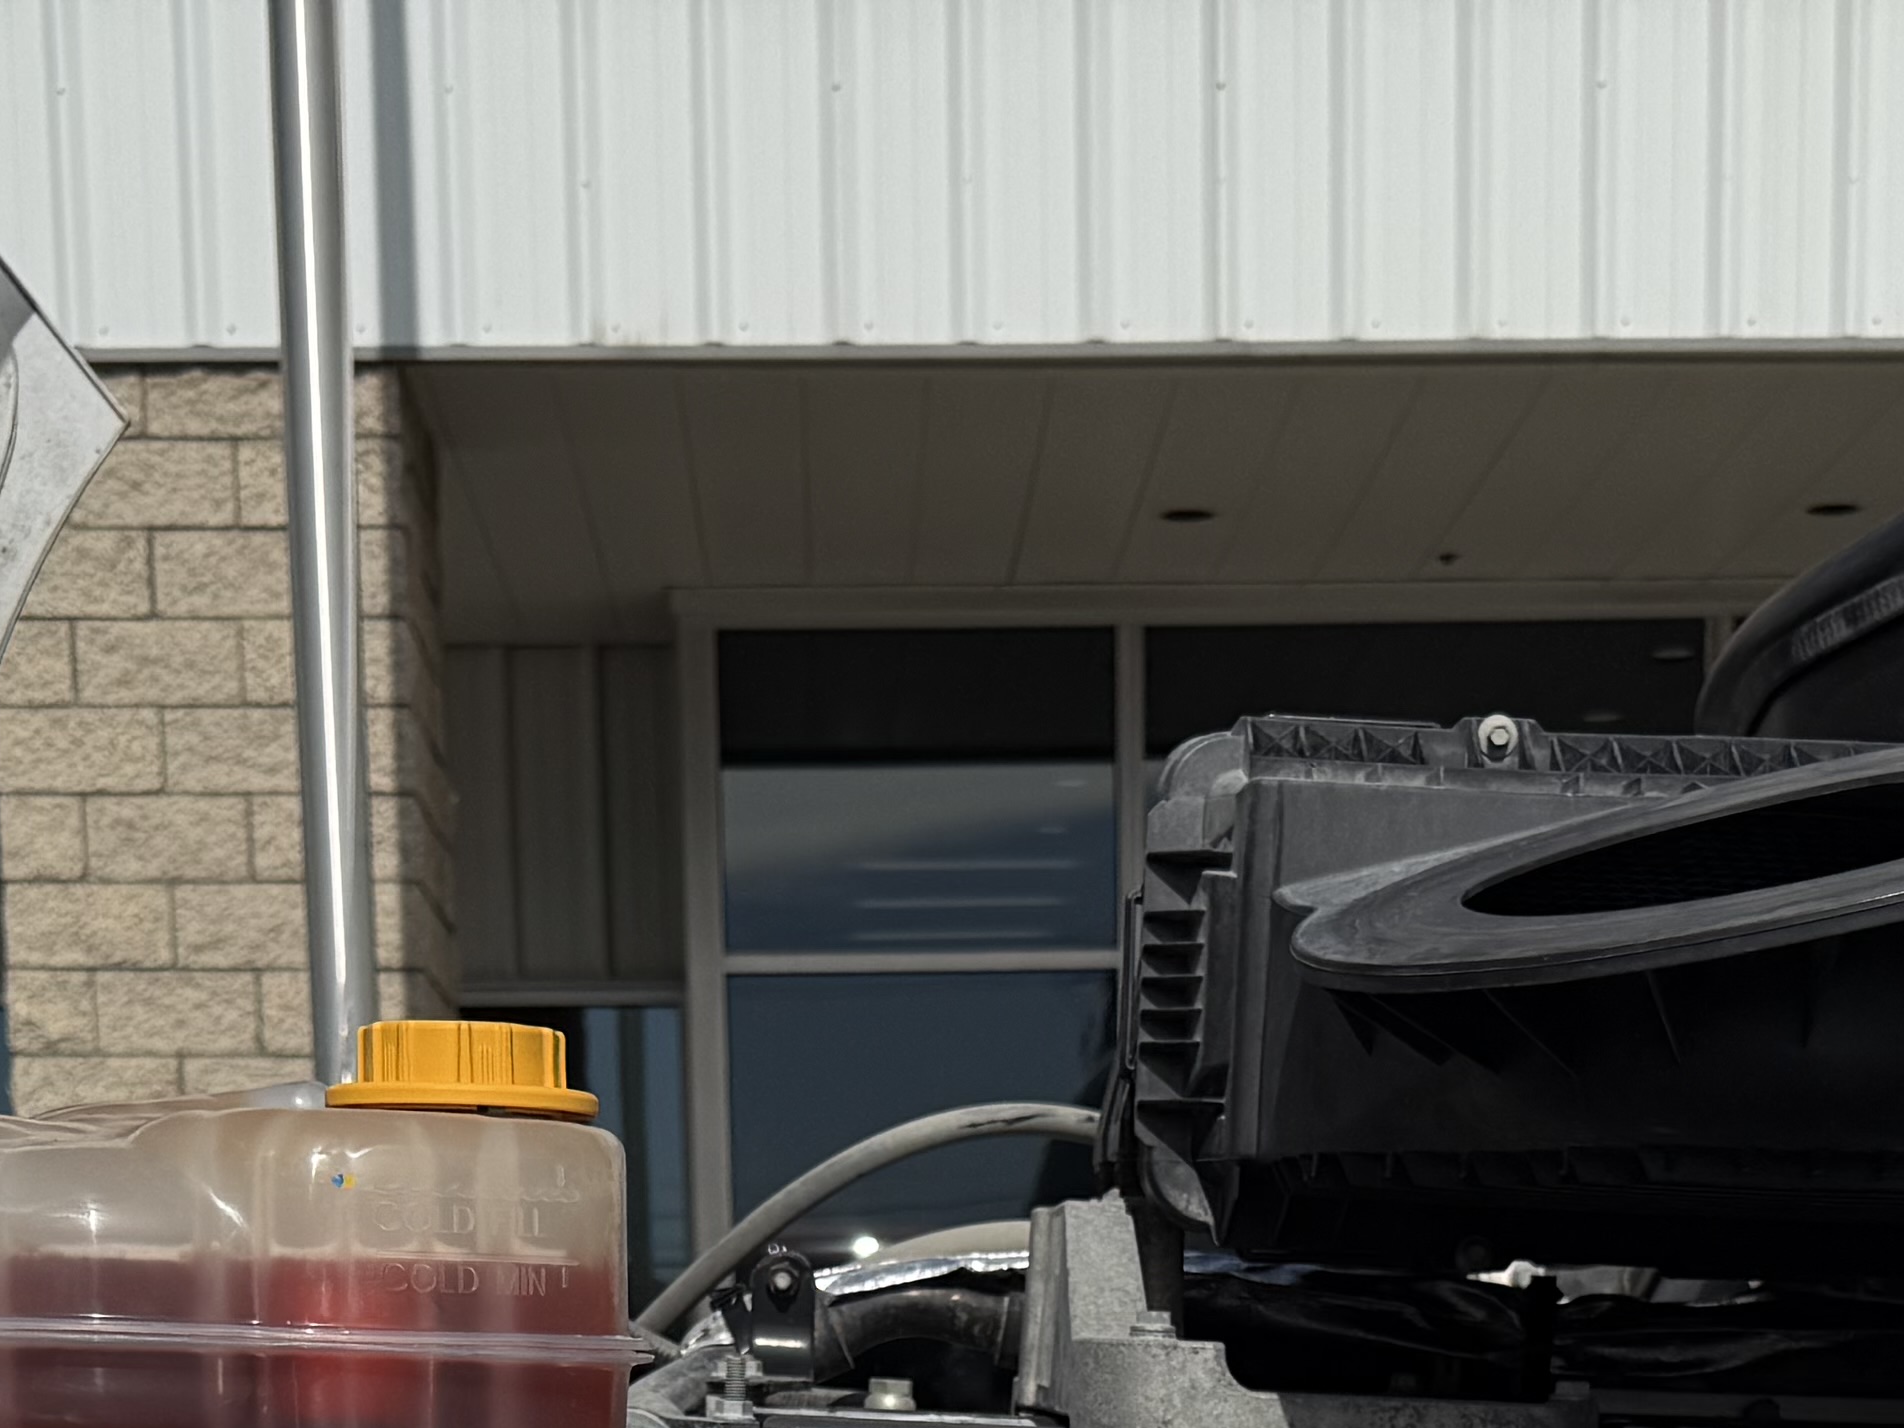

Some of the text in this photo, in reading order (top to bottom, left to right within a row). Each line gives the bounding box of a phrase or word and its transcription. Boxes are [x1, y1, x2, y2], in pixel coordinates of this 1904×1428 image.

[374, 1201, 475, 1234] COLD
[382, 1262, 547, 1297] COLD MIN
